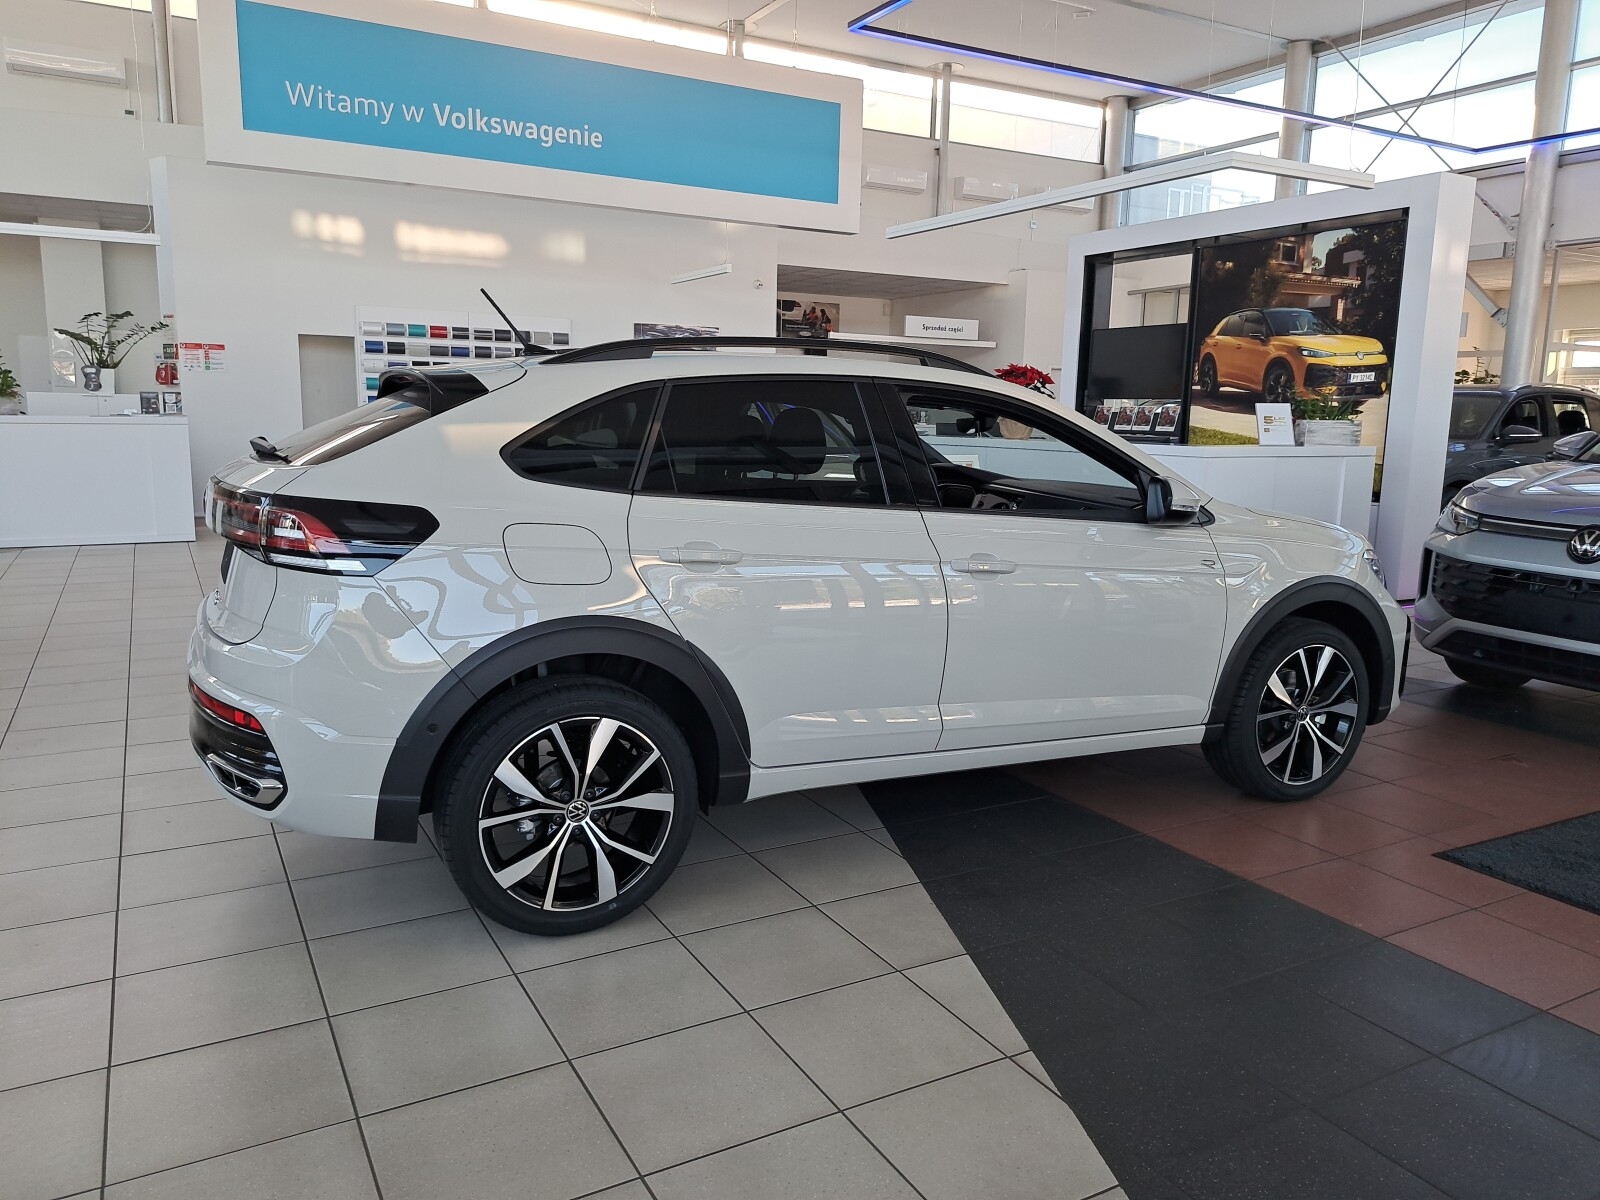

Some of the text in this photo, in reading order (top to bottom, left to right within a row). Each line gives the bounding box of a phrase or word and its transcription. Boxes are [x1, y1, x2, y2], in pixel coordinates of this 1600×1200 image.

[286, 80, 604, 149] Witamy w Volkswagenie
[922, 323, 947, 332] Sprzedaż
